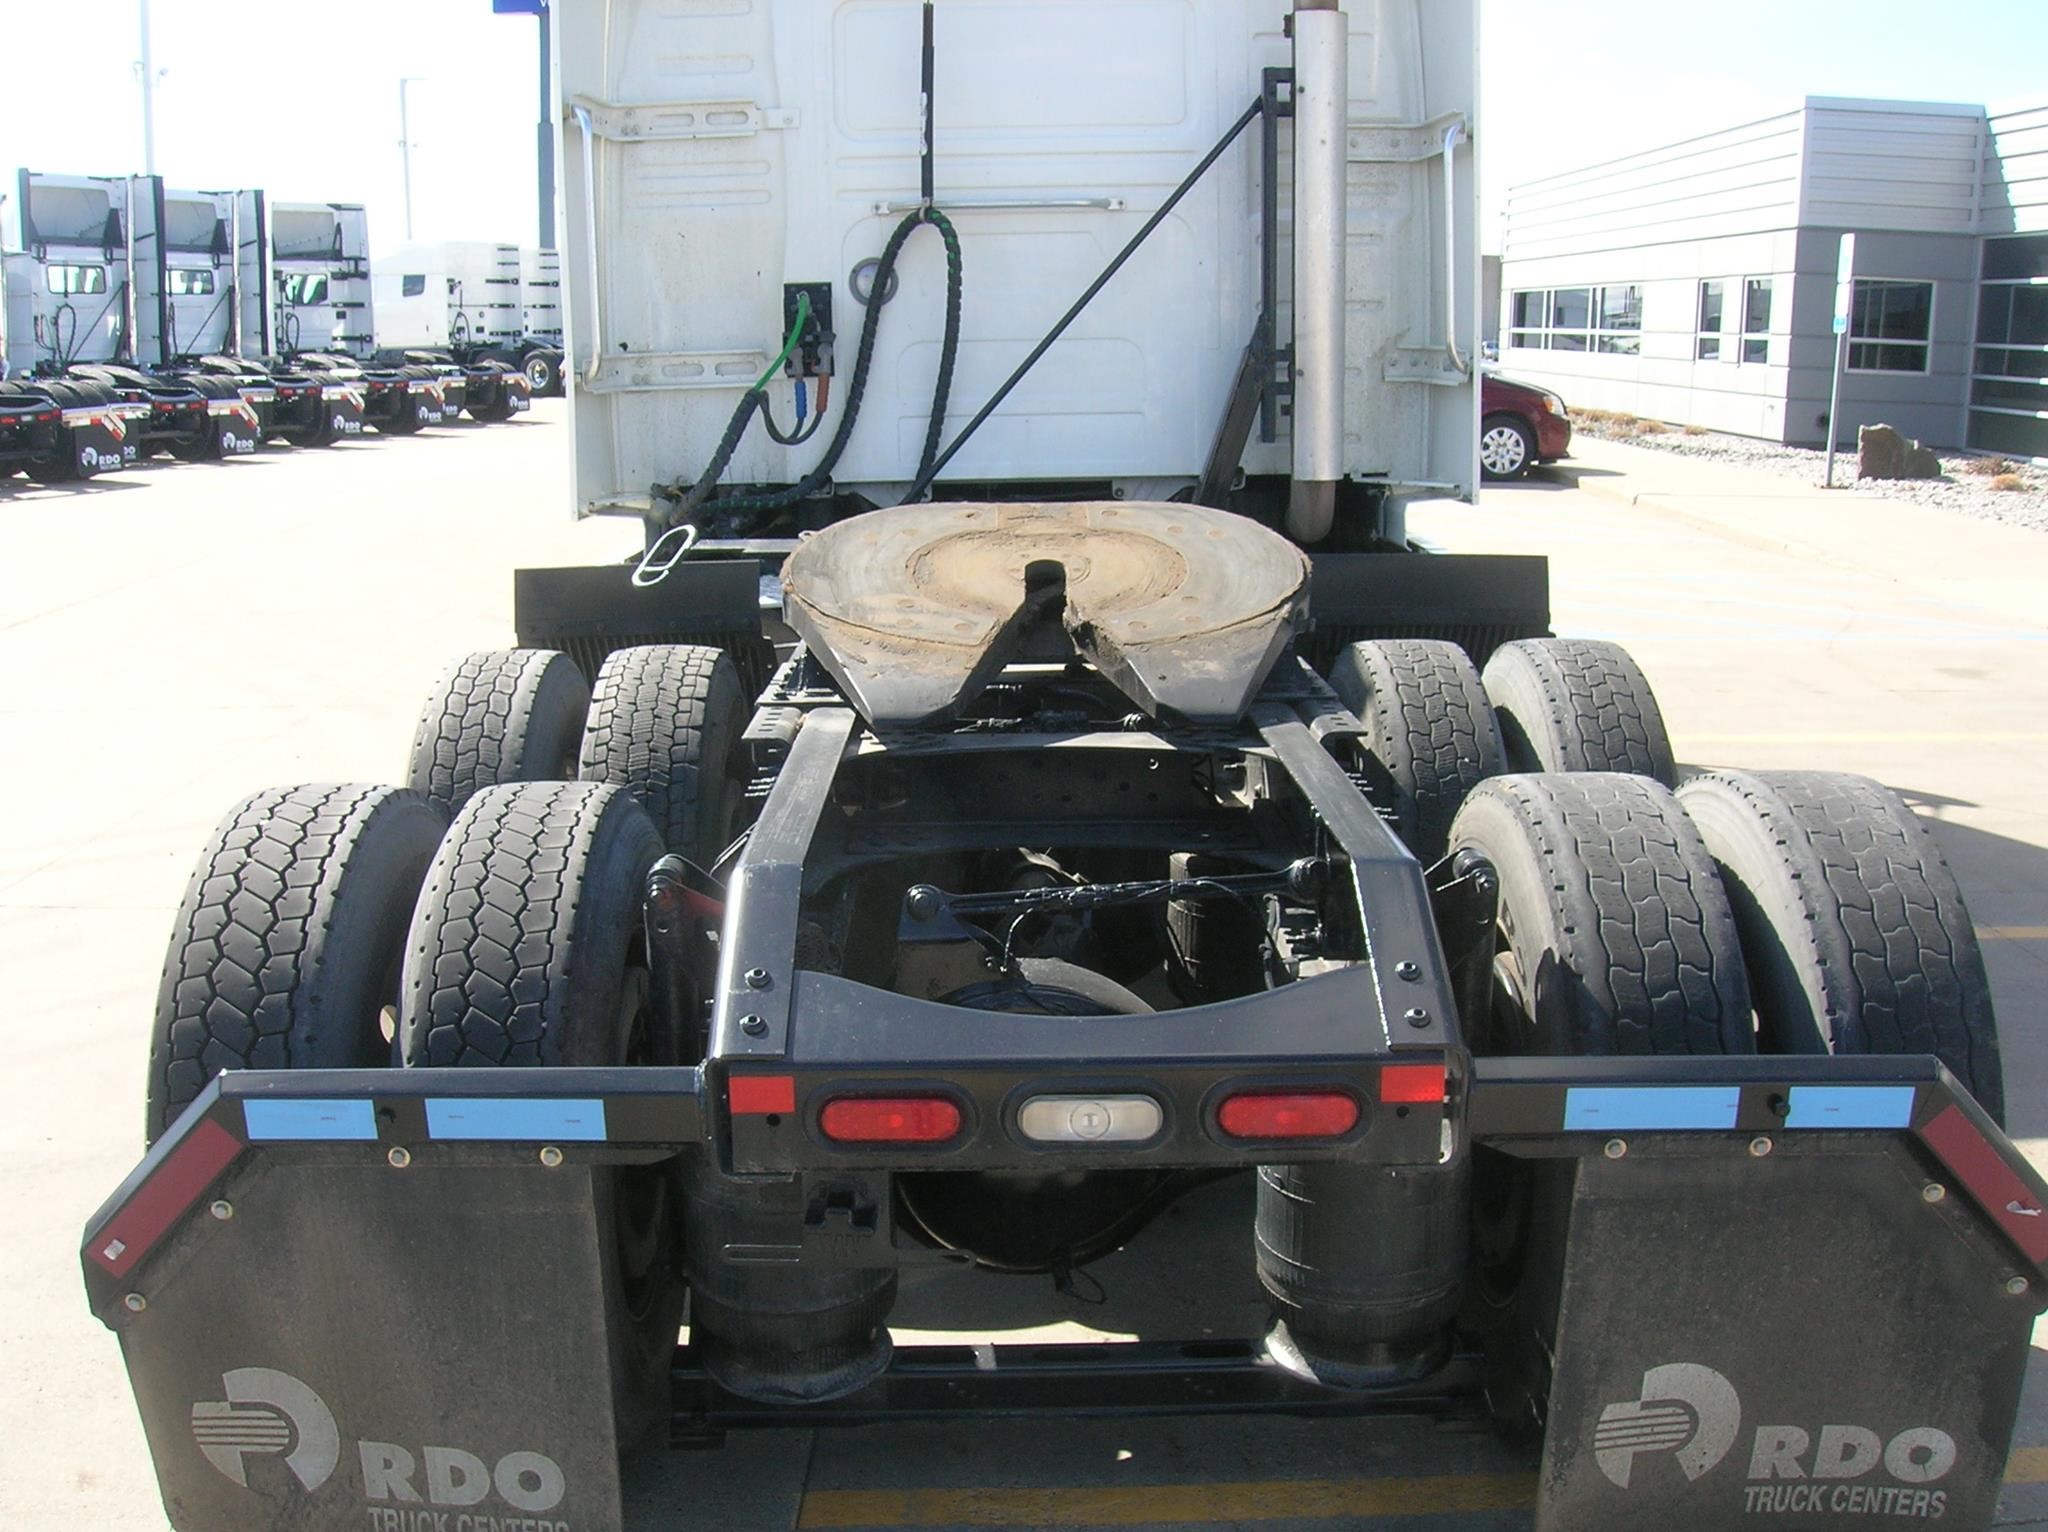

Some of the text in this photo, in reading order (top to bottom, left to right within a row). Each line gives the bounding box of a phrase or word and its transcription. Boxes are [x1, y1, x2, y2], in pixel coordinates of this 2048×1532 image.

[99, 453, 120, 465] RDO
[1747, 1425, 1957, 1483] RDO
[358, 1440, 565, 1511] RDO
[1744, 1485, 1947, 1518] TRUCK CENTERS
[368, 1507, 449, 1532] TRUCK
